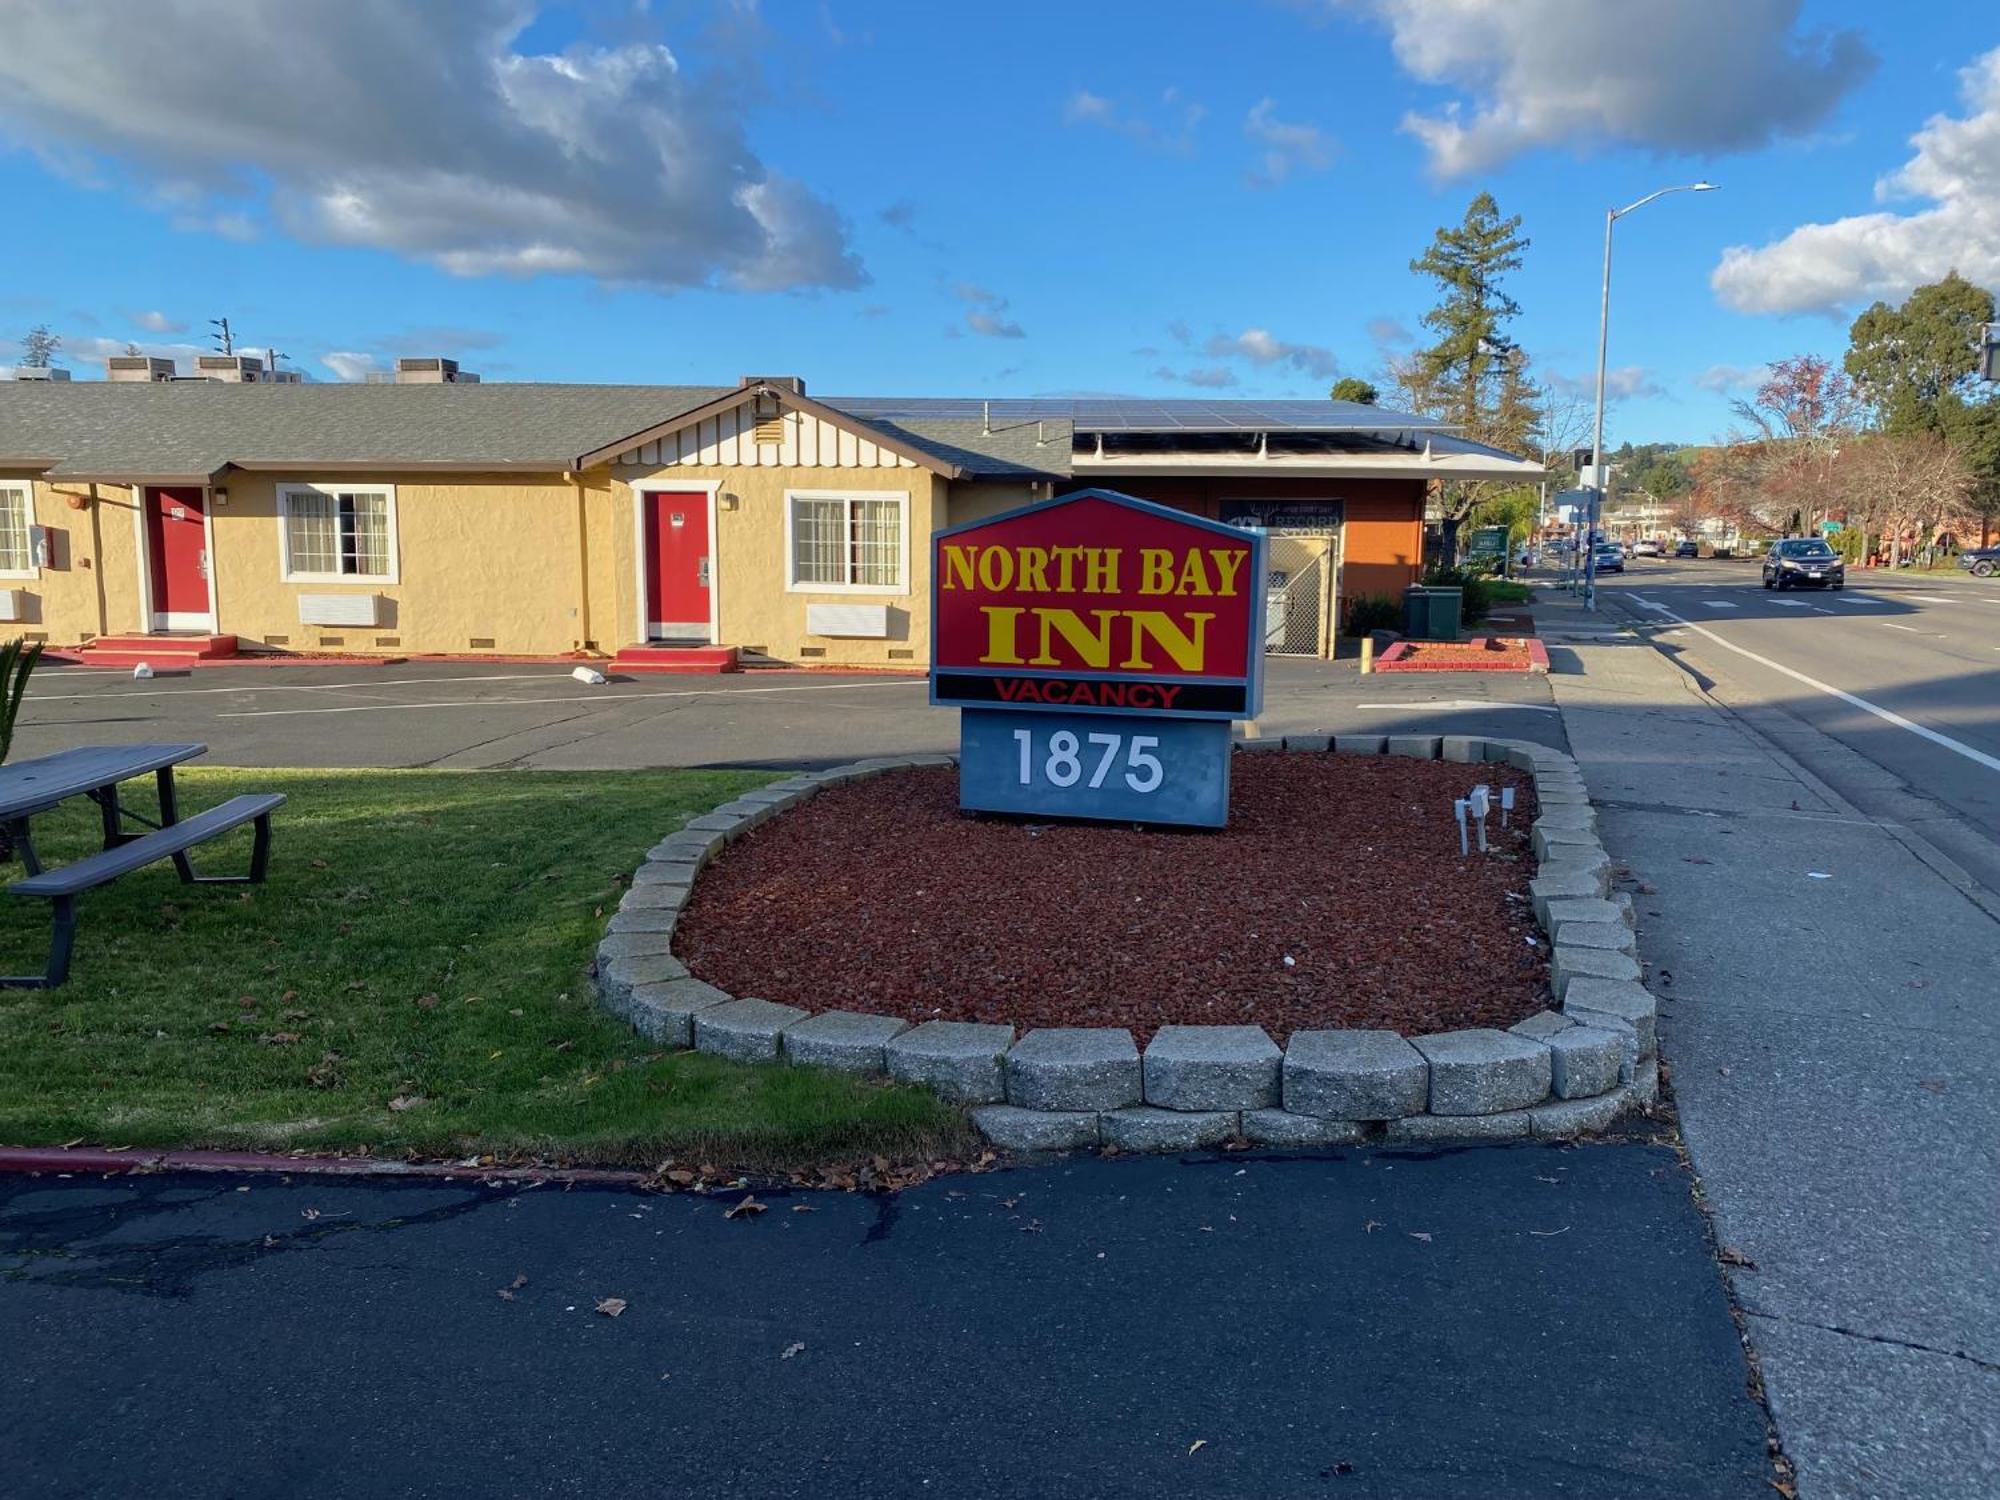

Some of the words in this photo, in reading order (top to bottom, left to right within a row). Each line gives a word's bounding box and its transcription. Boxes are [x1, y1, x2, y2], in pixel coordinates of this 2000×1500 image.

[1275, 515, 1339, 528] RECORD
[942, 545, 1122, 594] NORTH
[1138, 548, 1249, 596] BAY
[979, 606, 1215, 672] INN
[993, 679, 1181, 708] VACANCY
[1014, 729, 1163, 792] 1875
